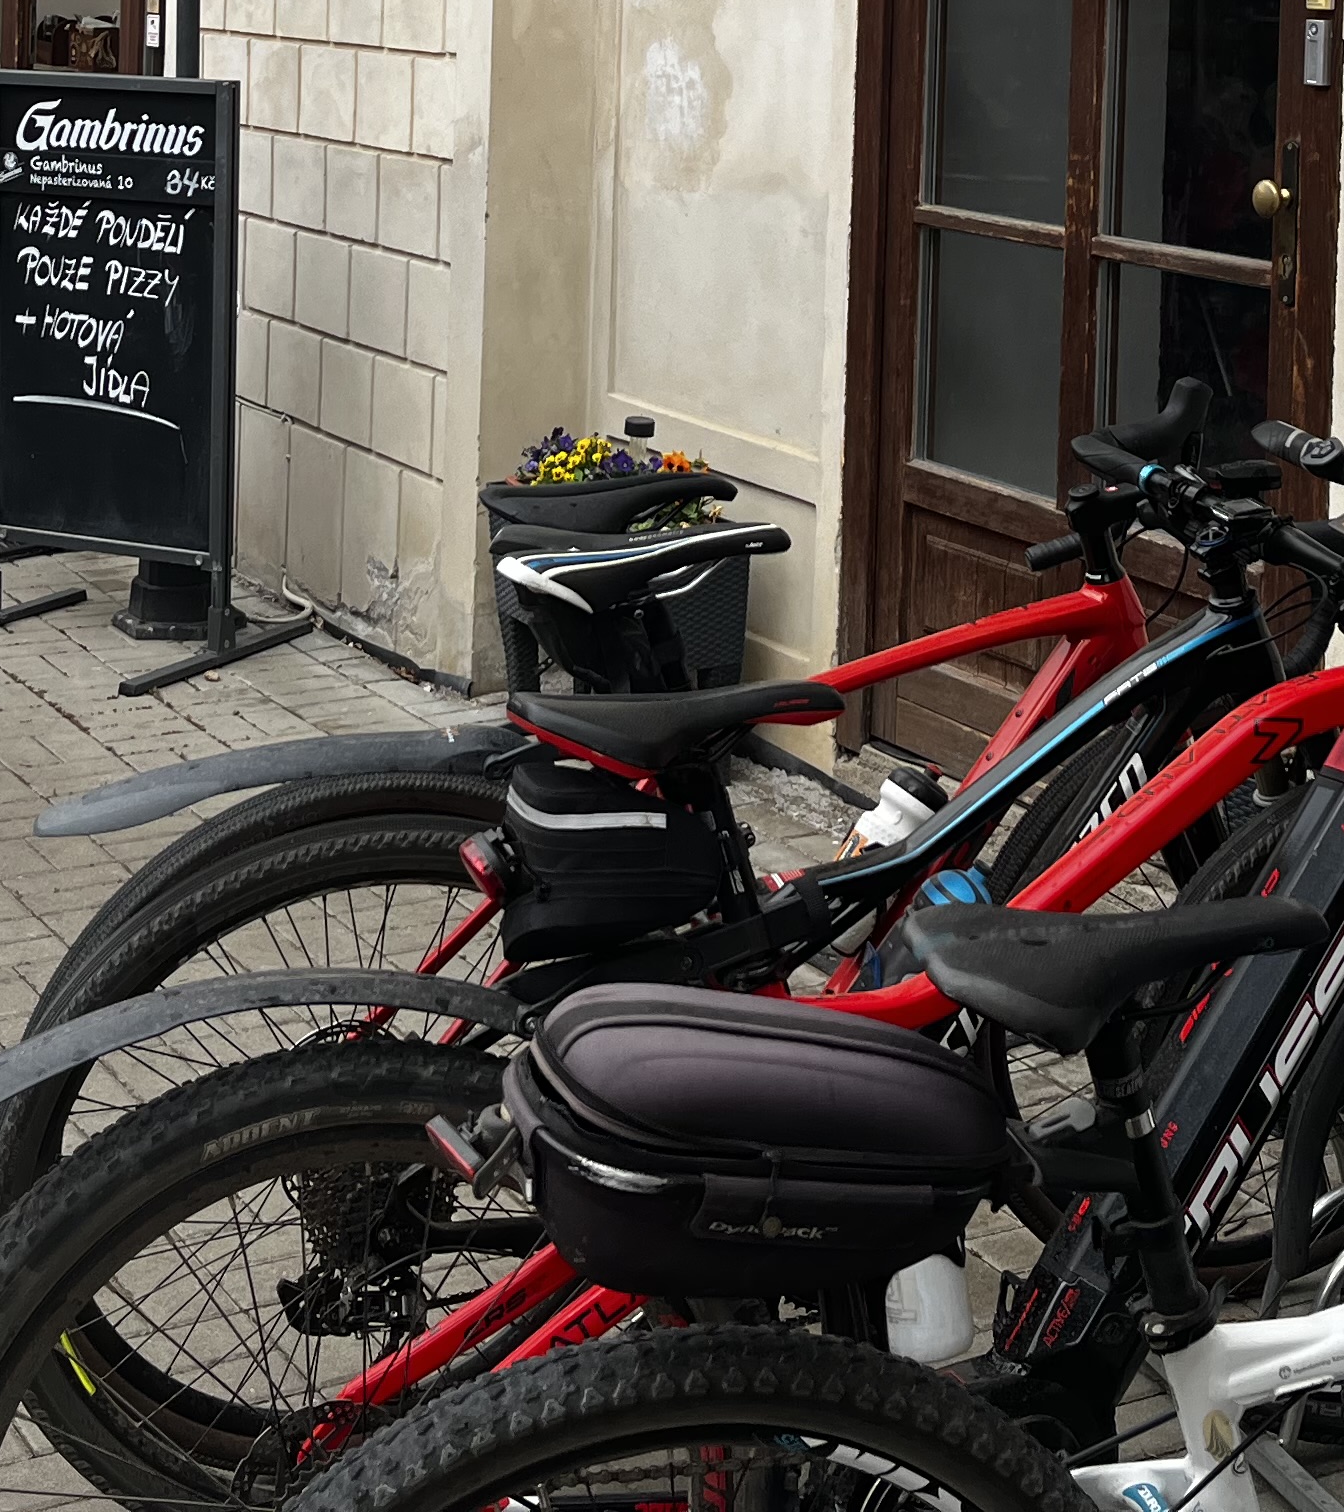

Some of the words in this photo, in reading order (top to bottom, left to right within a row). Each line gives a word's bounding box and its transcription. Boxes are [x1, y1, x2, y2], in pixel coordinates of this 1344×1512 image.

[15, 98, 205, 157] Gambrinus
[29, 154, 104, 176] Gambrinus
[29, 173, 113, 191] Nepasterizovaná
[117, 175, 134, 189] 10
[200, 175, 216, 191] Kč
[13, 200, 93, 239] KAŽDÉ
[16, 245, 95, 292] POUZE
[105, 260, 179, 308] PIZZY
[41, 303, 136, 354] HOTOVÁ
[82, 353, 150, 408] JÍDLA
